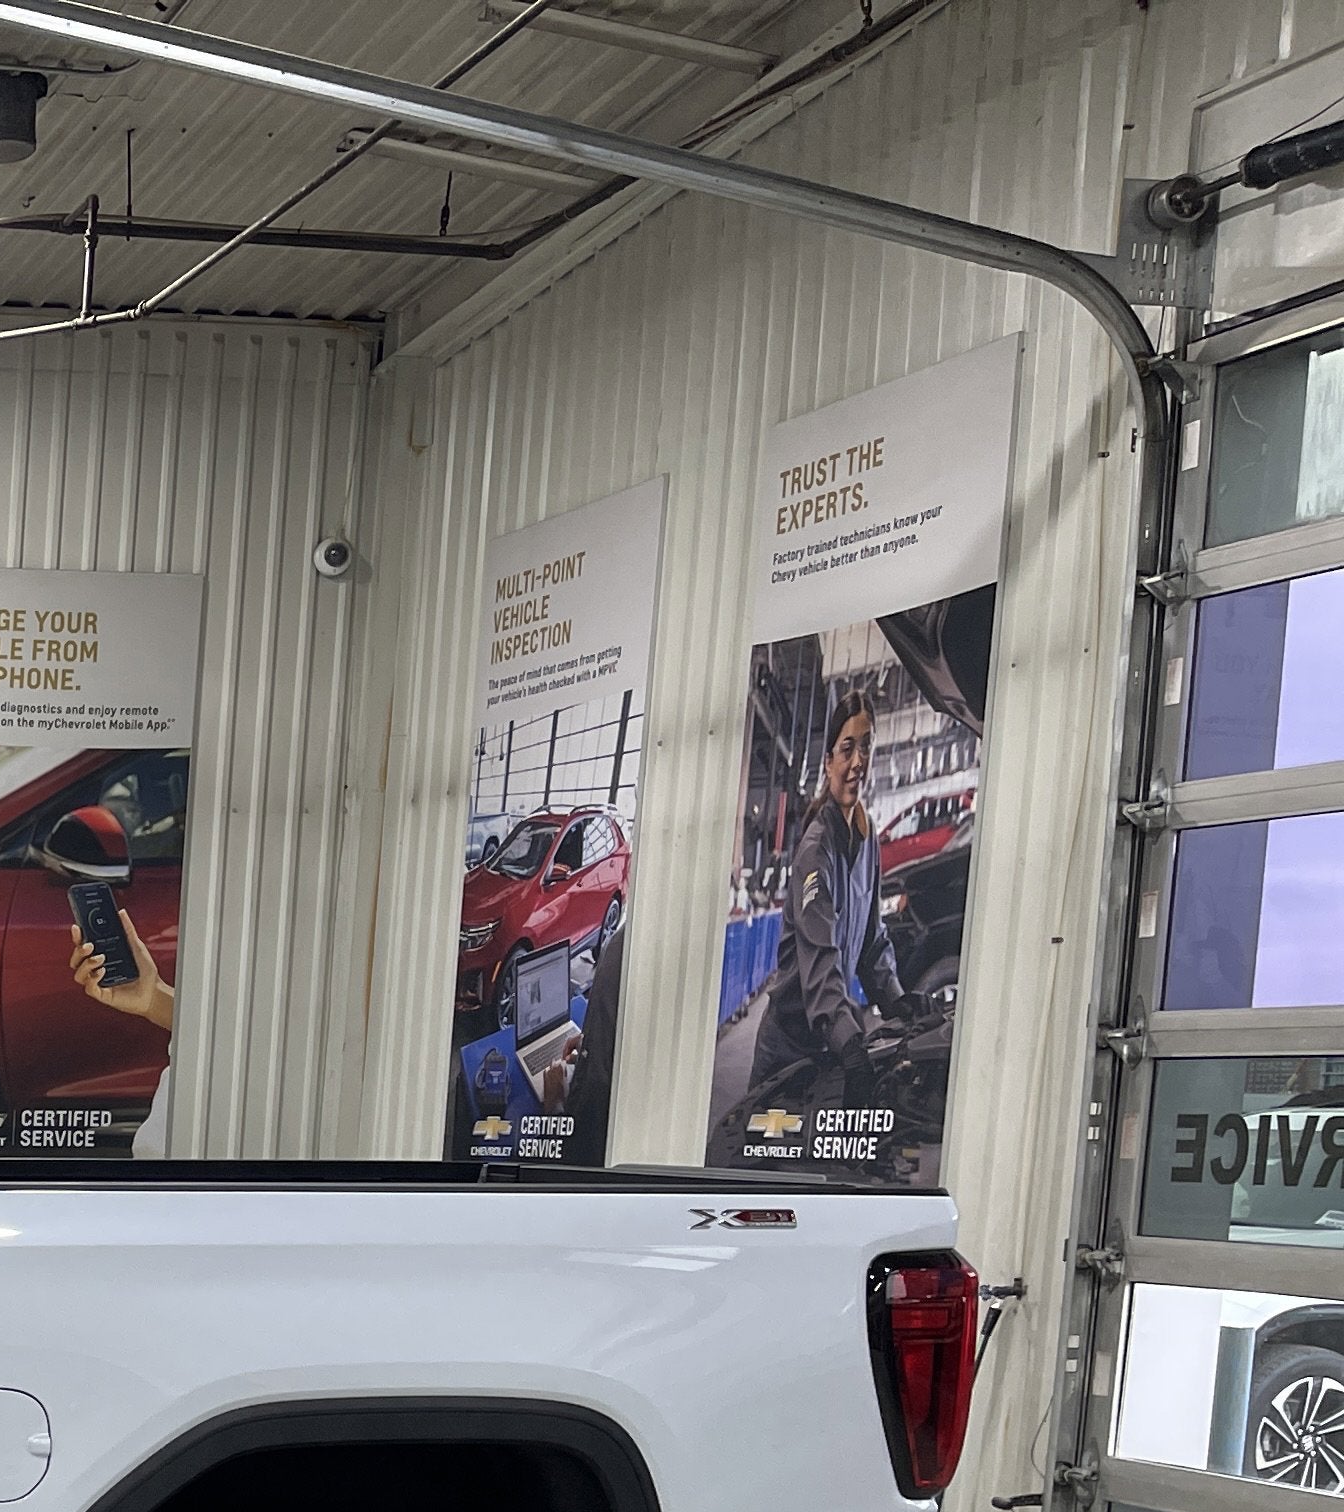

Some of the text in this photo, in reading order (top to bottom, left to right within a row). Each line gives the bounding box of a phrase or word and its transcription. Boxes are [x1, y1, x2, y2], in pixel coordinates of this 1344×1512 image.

[779, 436, 885, 499] TRUST THE
[775, 482, 869, 536] EXPERTS.
[772, 504, 944, 567] Factory trained technicians know your
[770, 532, 920, 584] Chevy vehicle better than anyone.
[495, 550, 587, 604] MULTI-POINT
[34, 610, 98, 634] YOUR
[493, 594, 551, 634] VEHICLE
[32, 639, 98, 663] FROM
[490, 618, 572, 666] INSPECTION
[488, 645, 623, 691] The peace of mind that comes from getting
[486, 692, 501, 710] your
[527, 679, 549, 696] health
[548, 674, 575, 692] checked
[576, 669, 592, 684] with
[0, 702, 62, 717] diagnostics
[65, 703, 85, 716] and
[88, 704, 117, 718] enjoy
[120, 705, 159, 717] remote
[0, 715, 14, 727] on
[17, 715, 34, 727] the
[37, 716, 106, 732] myChevrolet
[109, 718, 144, 731] Mobile
[20, 1109, 113, 1127] CERTIFIED
[520, 1115, 575, 1137] CERTIFIED
[815, 1108, 895, 1134] CERTIFIED
[19, 1130, 96, 1148] SERVICE
[517, 1137, 563, 1159] SERVICE
[812, 1136, 878, 1161] SERVICE
[470, 1146, 512, 1158] CHEVROLET
[743, 1145, 803, 1159] CHEVROLET
